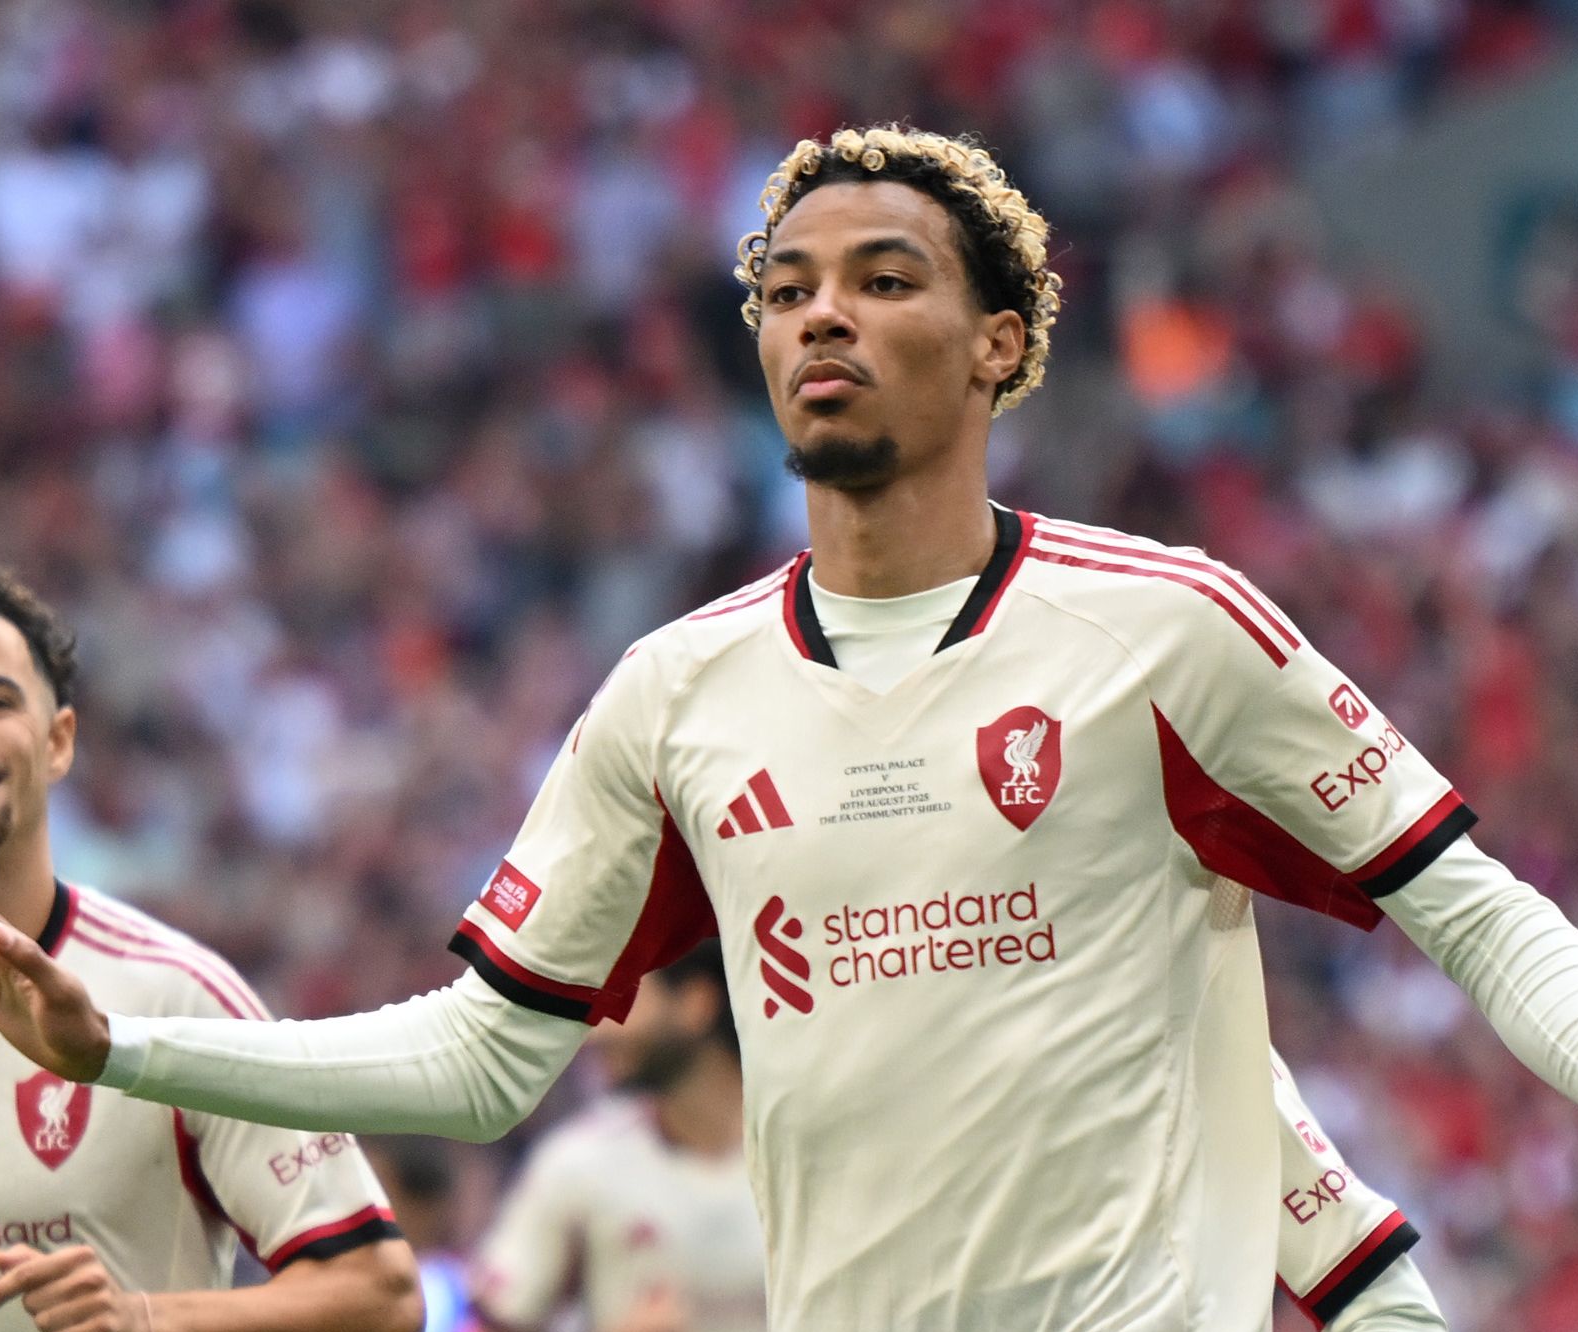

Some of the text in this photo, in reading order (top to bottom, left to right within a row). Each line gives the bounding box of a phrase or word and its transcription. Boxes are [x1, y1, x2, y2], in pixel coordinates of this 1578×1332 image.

[888, 758, 925, 770] PALACE
[850, 785, 905, 798] LIVERPOOL
[867, 796, 906, 808] AUGUST
[853, 806, 914, 822] COMMUNITY
[917, 802, 952, 815] SHIELD
[824, 882, 1038, 945] standard
[829, 922, 1056, 987] chartered
